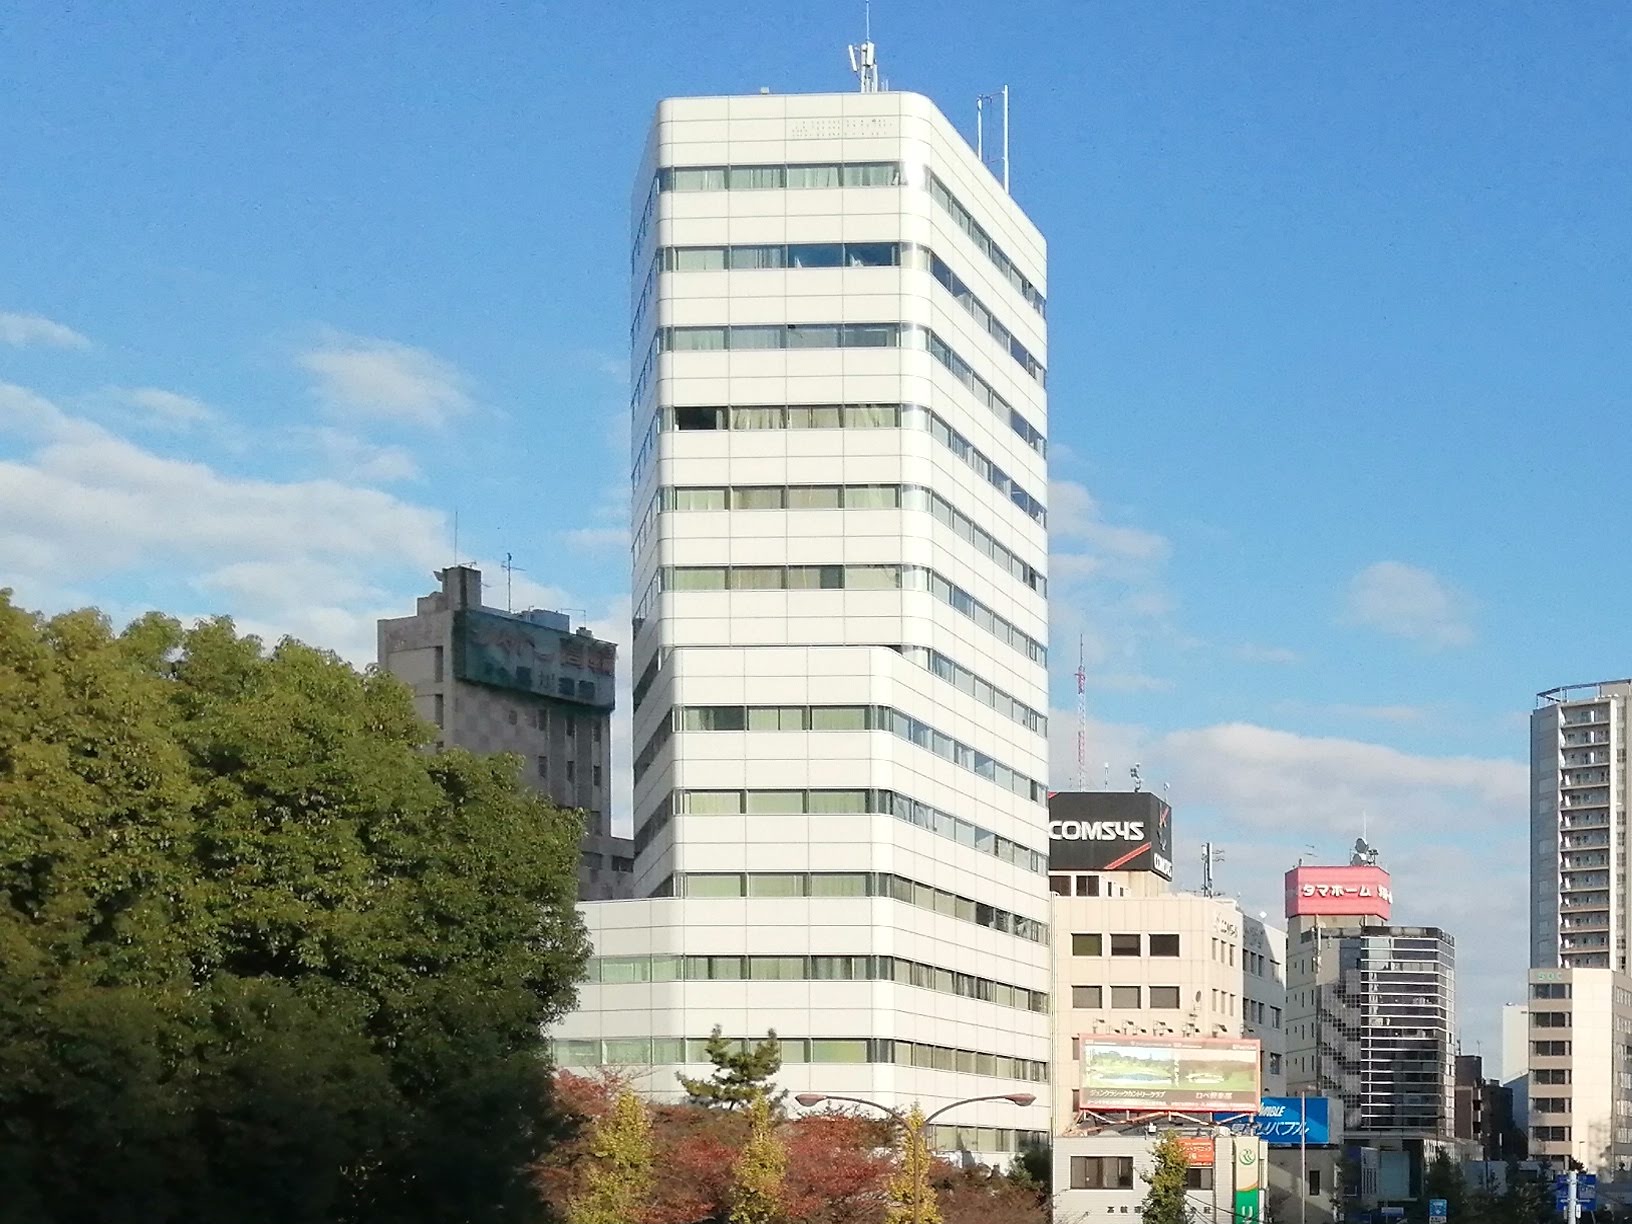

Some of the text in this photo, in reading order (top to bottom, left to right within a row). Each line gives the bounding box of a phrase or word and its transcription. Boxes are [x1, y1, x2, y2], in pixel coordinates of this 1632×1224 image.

[1048, 820, 1145, 841] COMSYS
[1302, 884, 1372, 898] タマホーム
